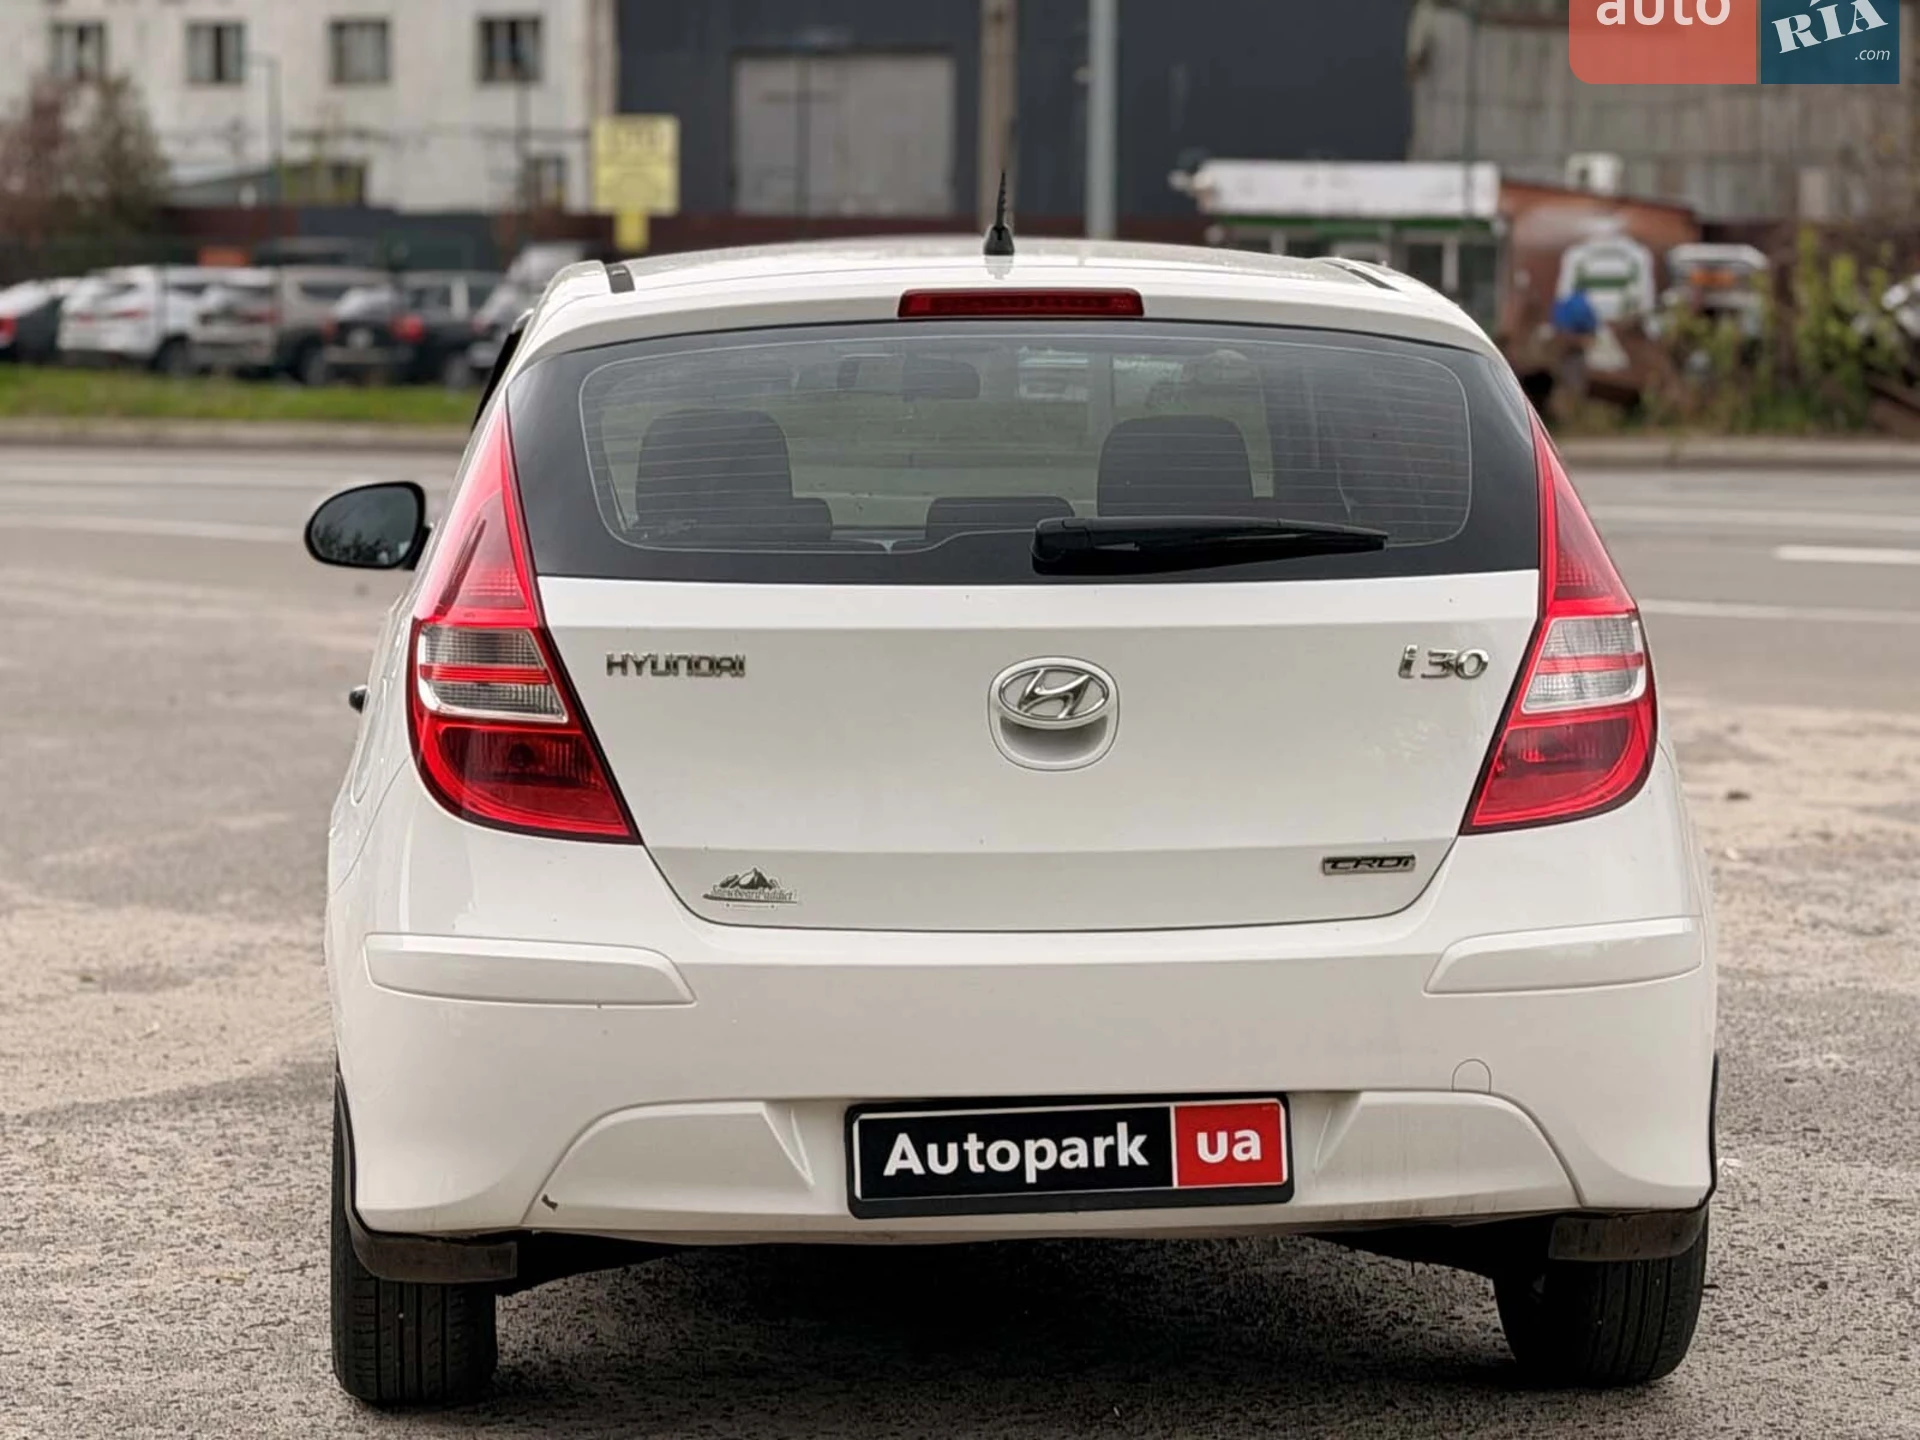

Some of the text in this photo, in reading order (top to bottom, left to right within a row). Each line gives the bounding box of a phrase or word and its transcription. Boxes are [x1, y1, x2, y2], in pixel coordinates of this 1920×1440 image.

[606, 652, 746, 677] HYUNDAI
[883, 1122, 1262, 1183] Autopark ua
